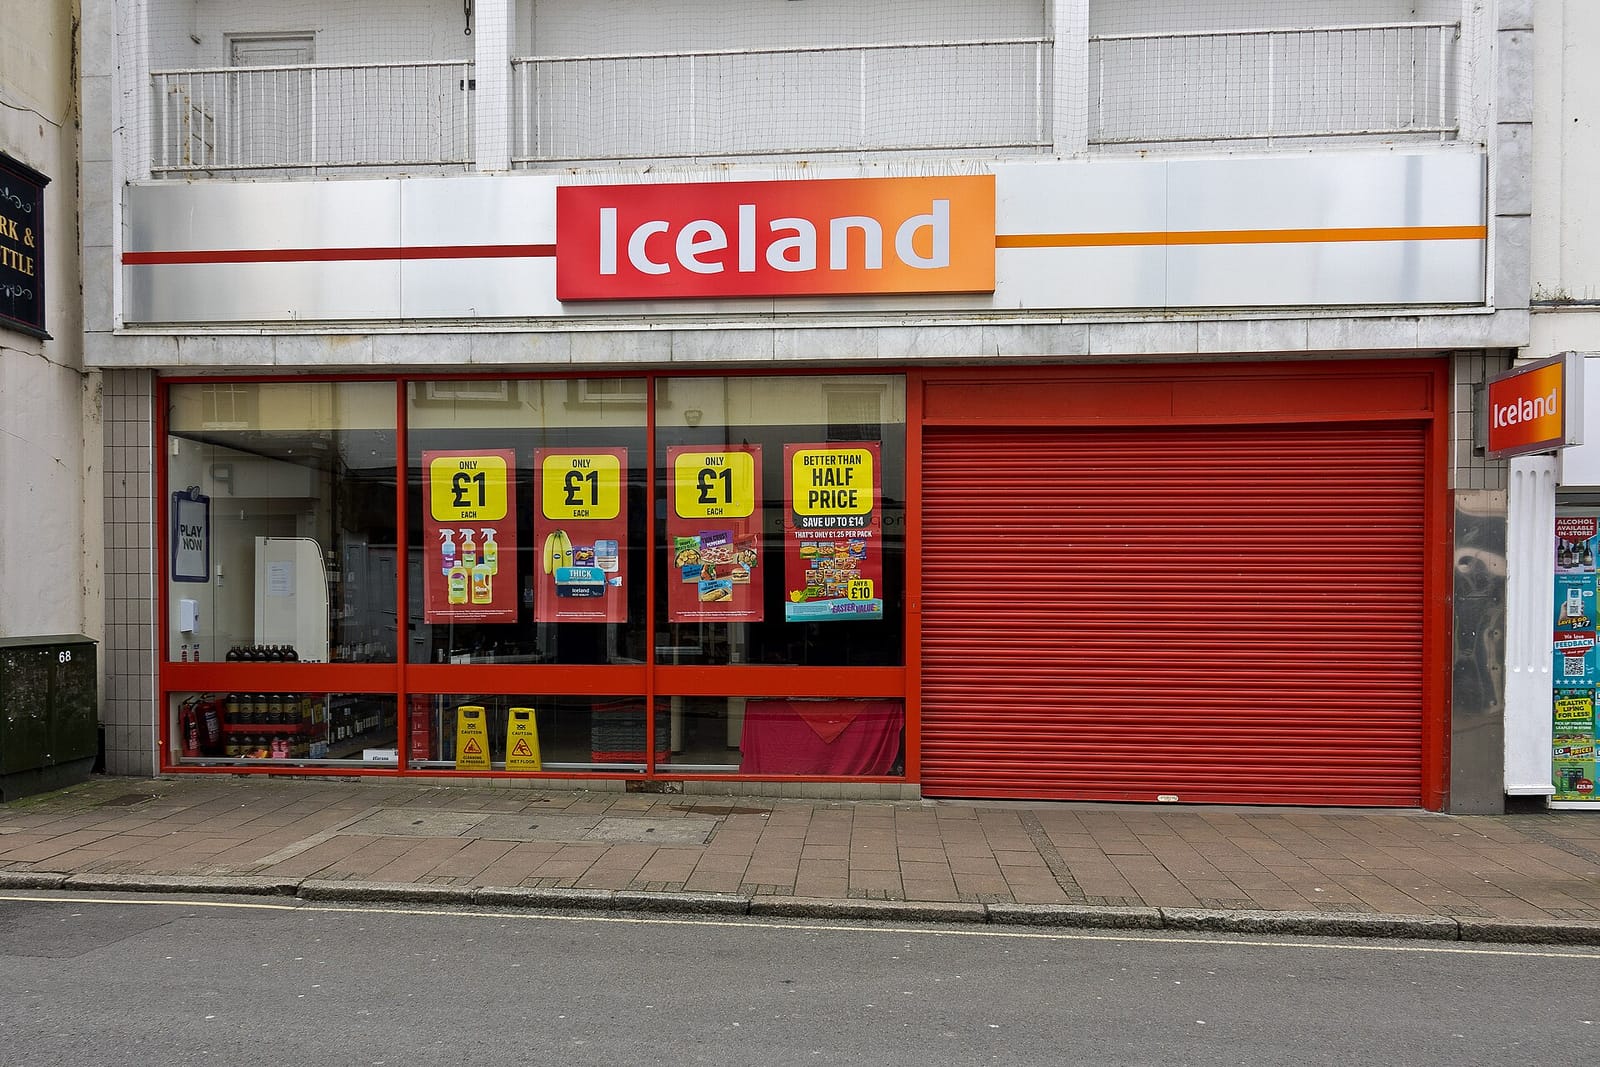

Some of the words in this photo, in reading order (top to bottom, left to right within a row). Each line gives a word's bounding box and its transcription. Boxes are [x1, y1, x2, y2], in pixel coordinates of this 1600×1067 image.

[24, 227, 35, 248] &
[599, 199, 950, 275] Iceland
[1493, 388, 1557, 429] Iceland
[459, 461, 478, 470] ONLY
[572, 459, 591, 468] ONLY
[705, 457, 724, 466] ONLY
[803, 455, 836, 466] BETTER
[837, 454, 862, 465] THAN
[812, 467, 854, 487] HALF
[451, 472, 486, 507] £1
[563, 470, 598, 506] £1
[696, 468, 732, 504] £1
[808, 490, 858, 509] PRICE
[461, 511, 477, 519] EACH
[573, 509, 590, 517] EACH
[802, 517, 823, 527] SAVE
[824, 517, 835, 527] UP
[836, 516, 847, 527] TO
[848, 516, 864, 527] £14
[180, 524, 203, 538] PLAY
[183, 537, 203, 551] NOW
[569, 569, 592, 577] THICK
[851, 587, 870, 599] £10
[1572, 620, 1591, 629] 24/7
[1555, 639, 1593, 648] FEEDBACK
[58, 650, 72, 664] 68
[1557, 699, 1588, 707] HEALTHY
